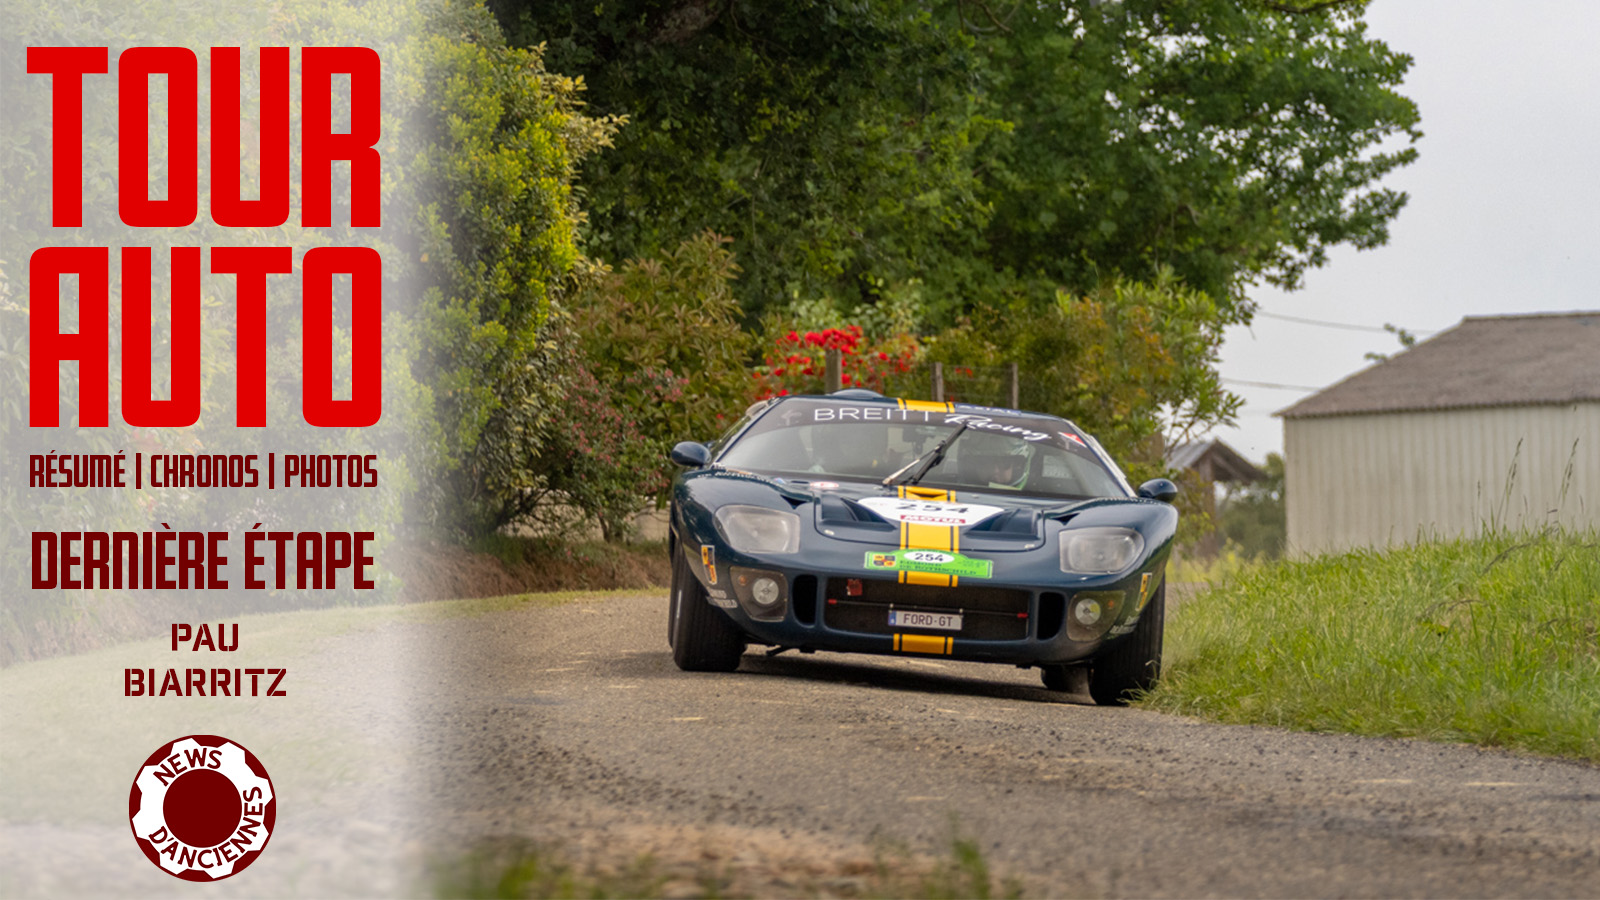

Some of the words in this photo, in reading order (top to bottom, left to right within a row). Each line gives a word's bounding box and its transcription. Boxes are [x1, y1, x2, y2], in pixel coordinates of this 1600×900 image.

[814, 407, 936, 422] BREITT
[896, 503, 969, 514] 254
[914, 552, 944, 563] 254
